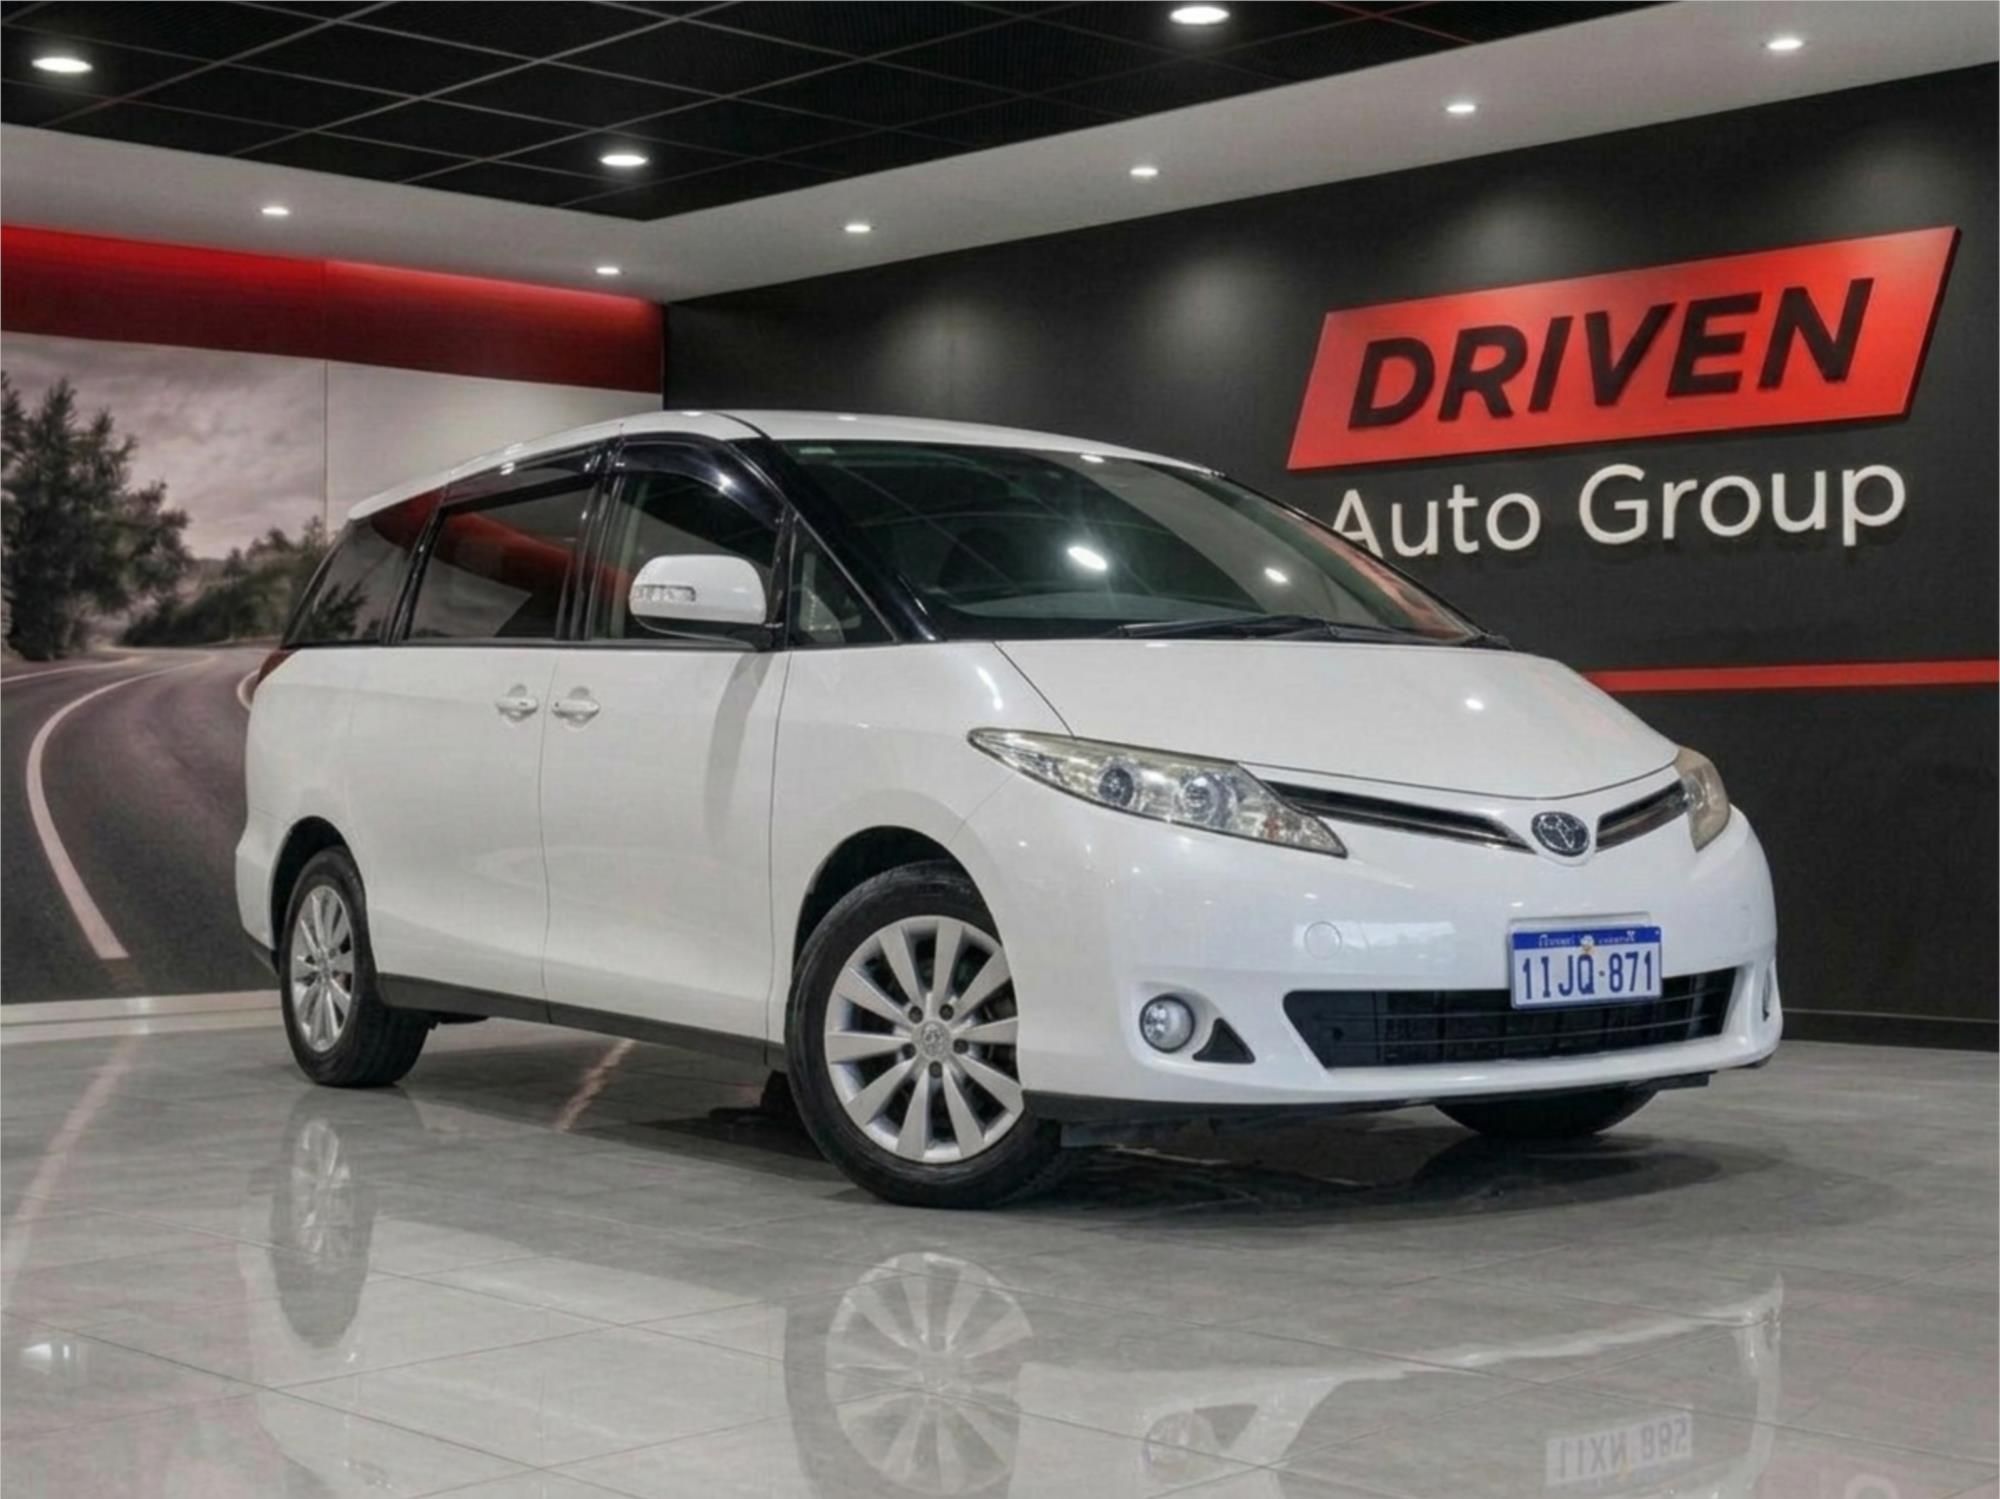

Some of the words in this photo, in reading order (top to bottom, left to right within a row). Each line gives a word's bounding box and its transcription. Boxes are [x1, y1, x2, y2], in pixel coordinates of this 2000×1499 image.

[1347, 276, 1874, 430] DRIVEN
[1333, 483, 1541, 558] Auto
[1579, 462, 1906, 547] Group
